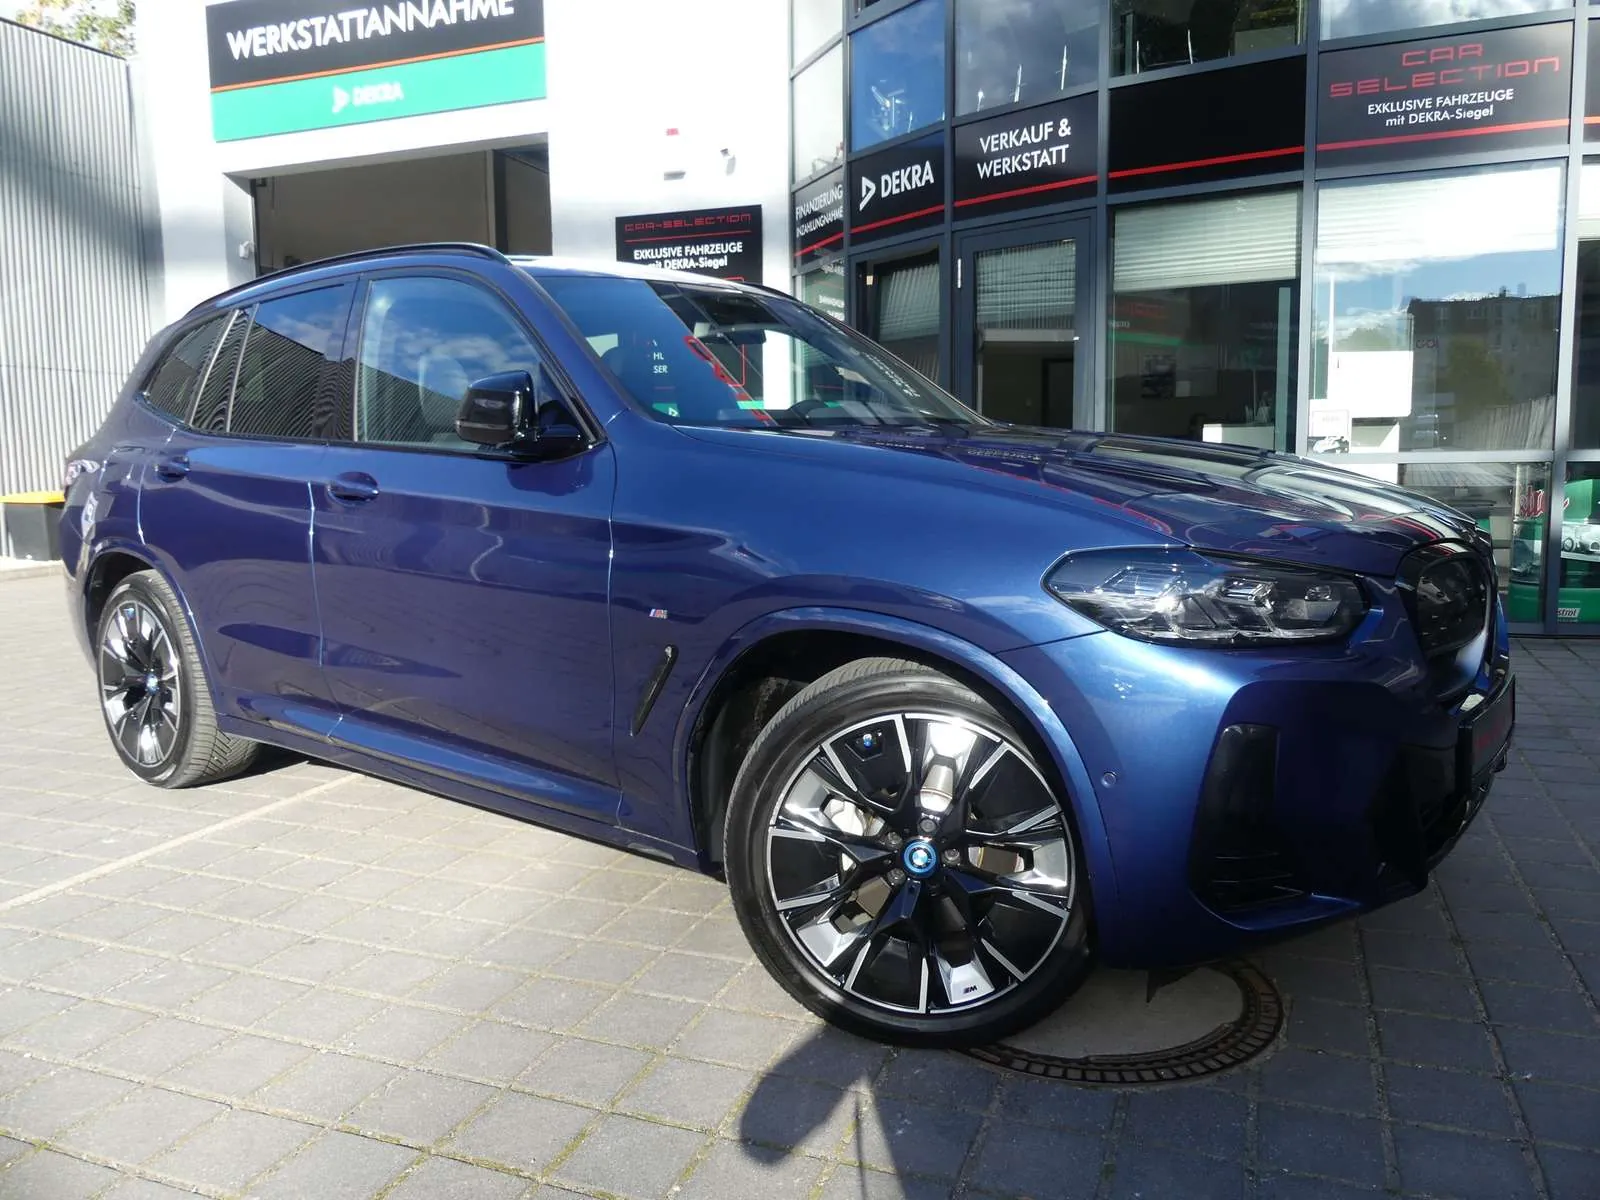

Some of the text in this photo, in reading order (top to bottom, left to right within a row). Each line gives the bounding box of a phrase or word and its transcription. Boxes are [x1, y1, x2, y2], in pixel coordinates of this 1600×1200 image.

[226, 0, 514, 60] WERKSTATTANNAHME
[1402, 43, 1483, 67] CAR
[1329, 56, 1560, 97] SELECTION
[1367, 88, 1514, 115] EXKLUSIVE FAHRZEUGE
[1385, 104, 1494, 127] mit DEKRA-Siegel
[980, 118, 1072, 154] VERKAUF &
[881, 160, 935, 199] DEKRA
[977, 144, 1070, 180] WERKSTATT
[795, 184, 844, 221] FINANZIERUNG
[633, 241, 743, 260] EXKLUSIVE FAHRZEUGE
[664, 255, 728, 270] DEKRA-Siegel
